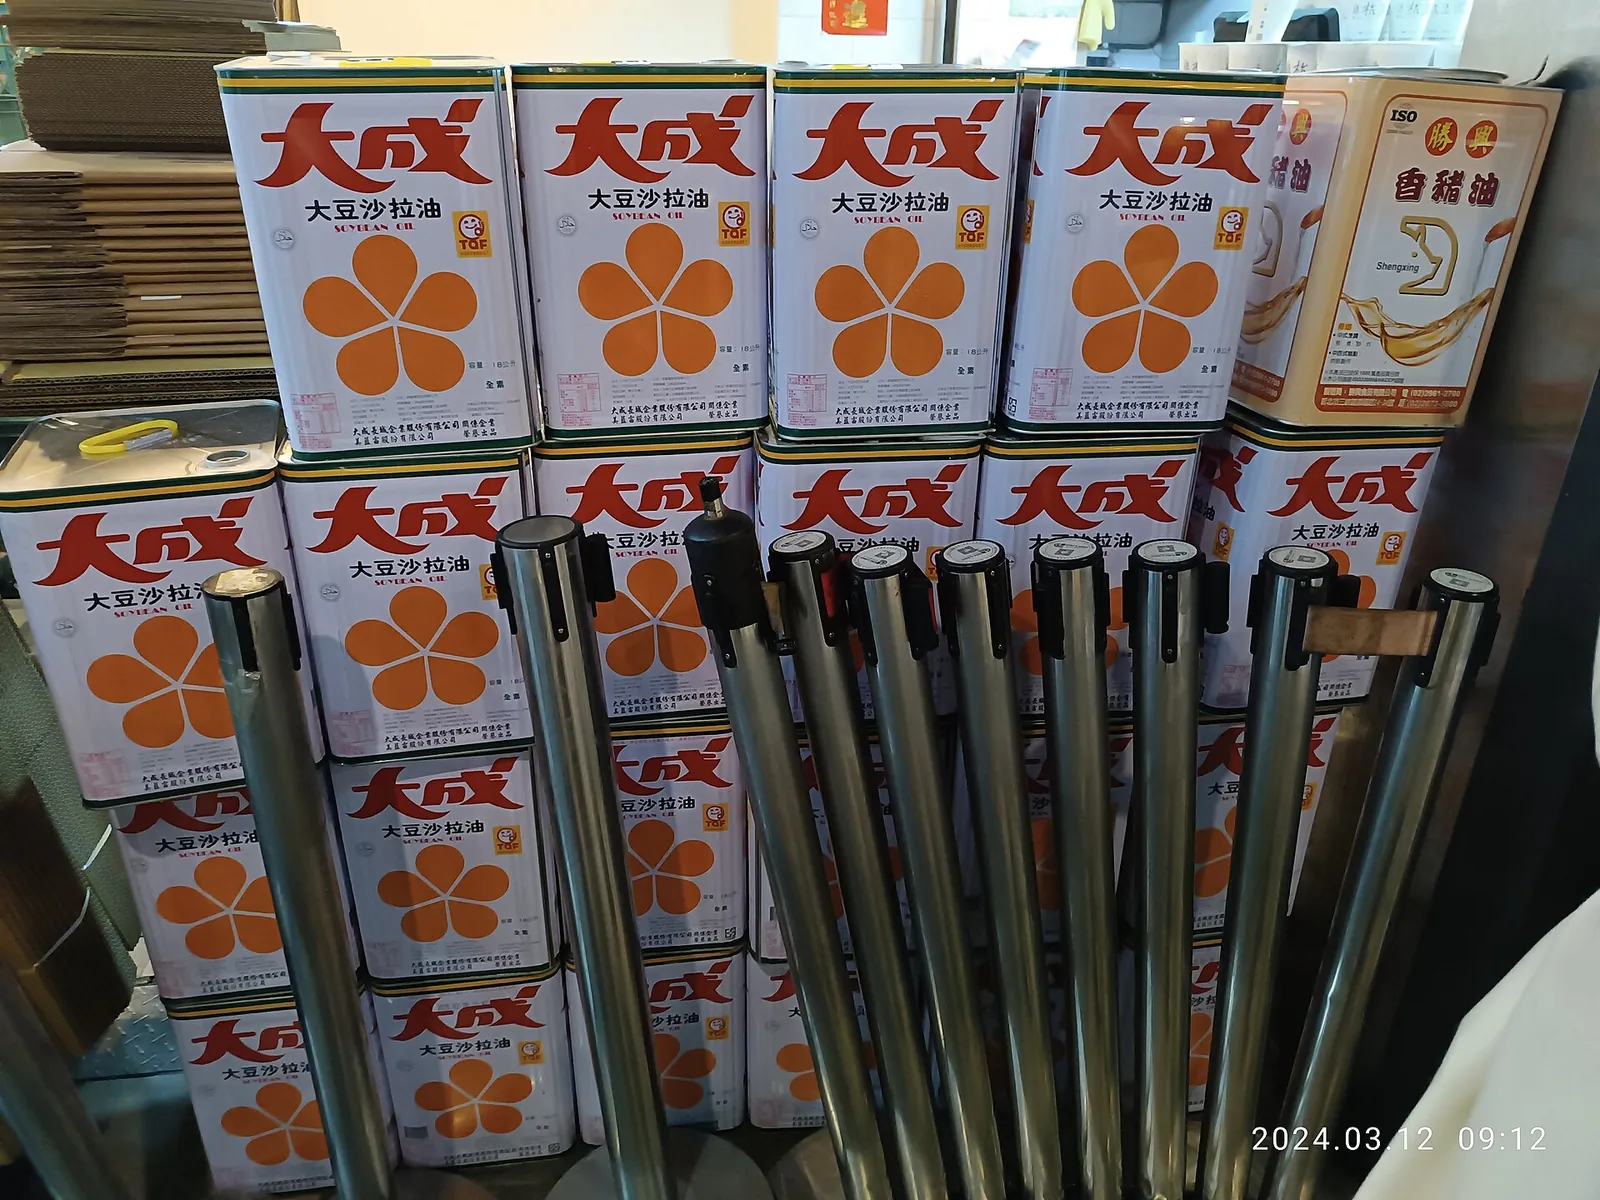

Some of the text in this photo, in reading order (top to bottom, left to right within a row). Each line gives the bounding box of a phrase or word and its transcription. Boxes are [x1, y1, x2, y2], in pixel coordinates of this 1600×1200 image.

[1390, 109, 1418, 123] ISO
[254, 98, 493, 193] 大成
[544, 95, 756, 183] 大成
[792, 100, 1004, 187] 大成
[1065, 101, 1274, 186] 大成
[305, 198, 442, 221] 大豆沙拉油
[588, 188, 709, 210] 大豆沙拉油
[832, 192, 949, 213] 大豆沙拉油
[1099, 189, 1213, 212] 大豆沙拉油
[1376, 261, 1420, 274] Shengxing
[566, 455, 741, 528] 大成
[995, 459, 1187, 530] 大成
[1266, 452, 1434, 520] 大成
[780, 464, 968, 534] 大成
[306, 476, 510, 555] 大成
[32, 496, 267, 586] 大成
[591, 530, 685, 549] 豆沙拉
[1029, 532, 1133, 550] 大拉油
[1291, 522, 1380, 541] 大豆沙拉油
[349, 555, 470, 578] 大豆沙拉油
[346, 756, 524, 820] 大成
[155, 829, 260, 853] 大豆沙拉油
[381, 819, 484, 839] 大豆沙拉油
[388, 984, 546, 1041] 大成
[419, 1037, 511, 1057] 大豆沙拉油
